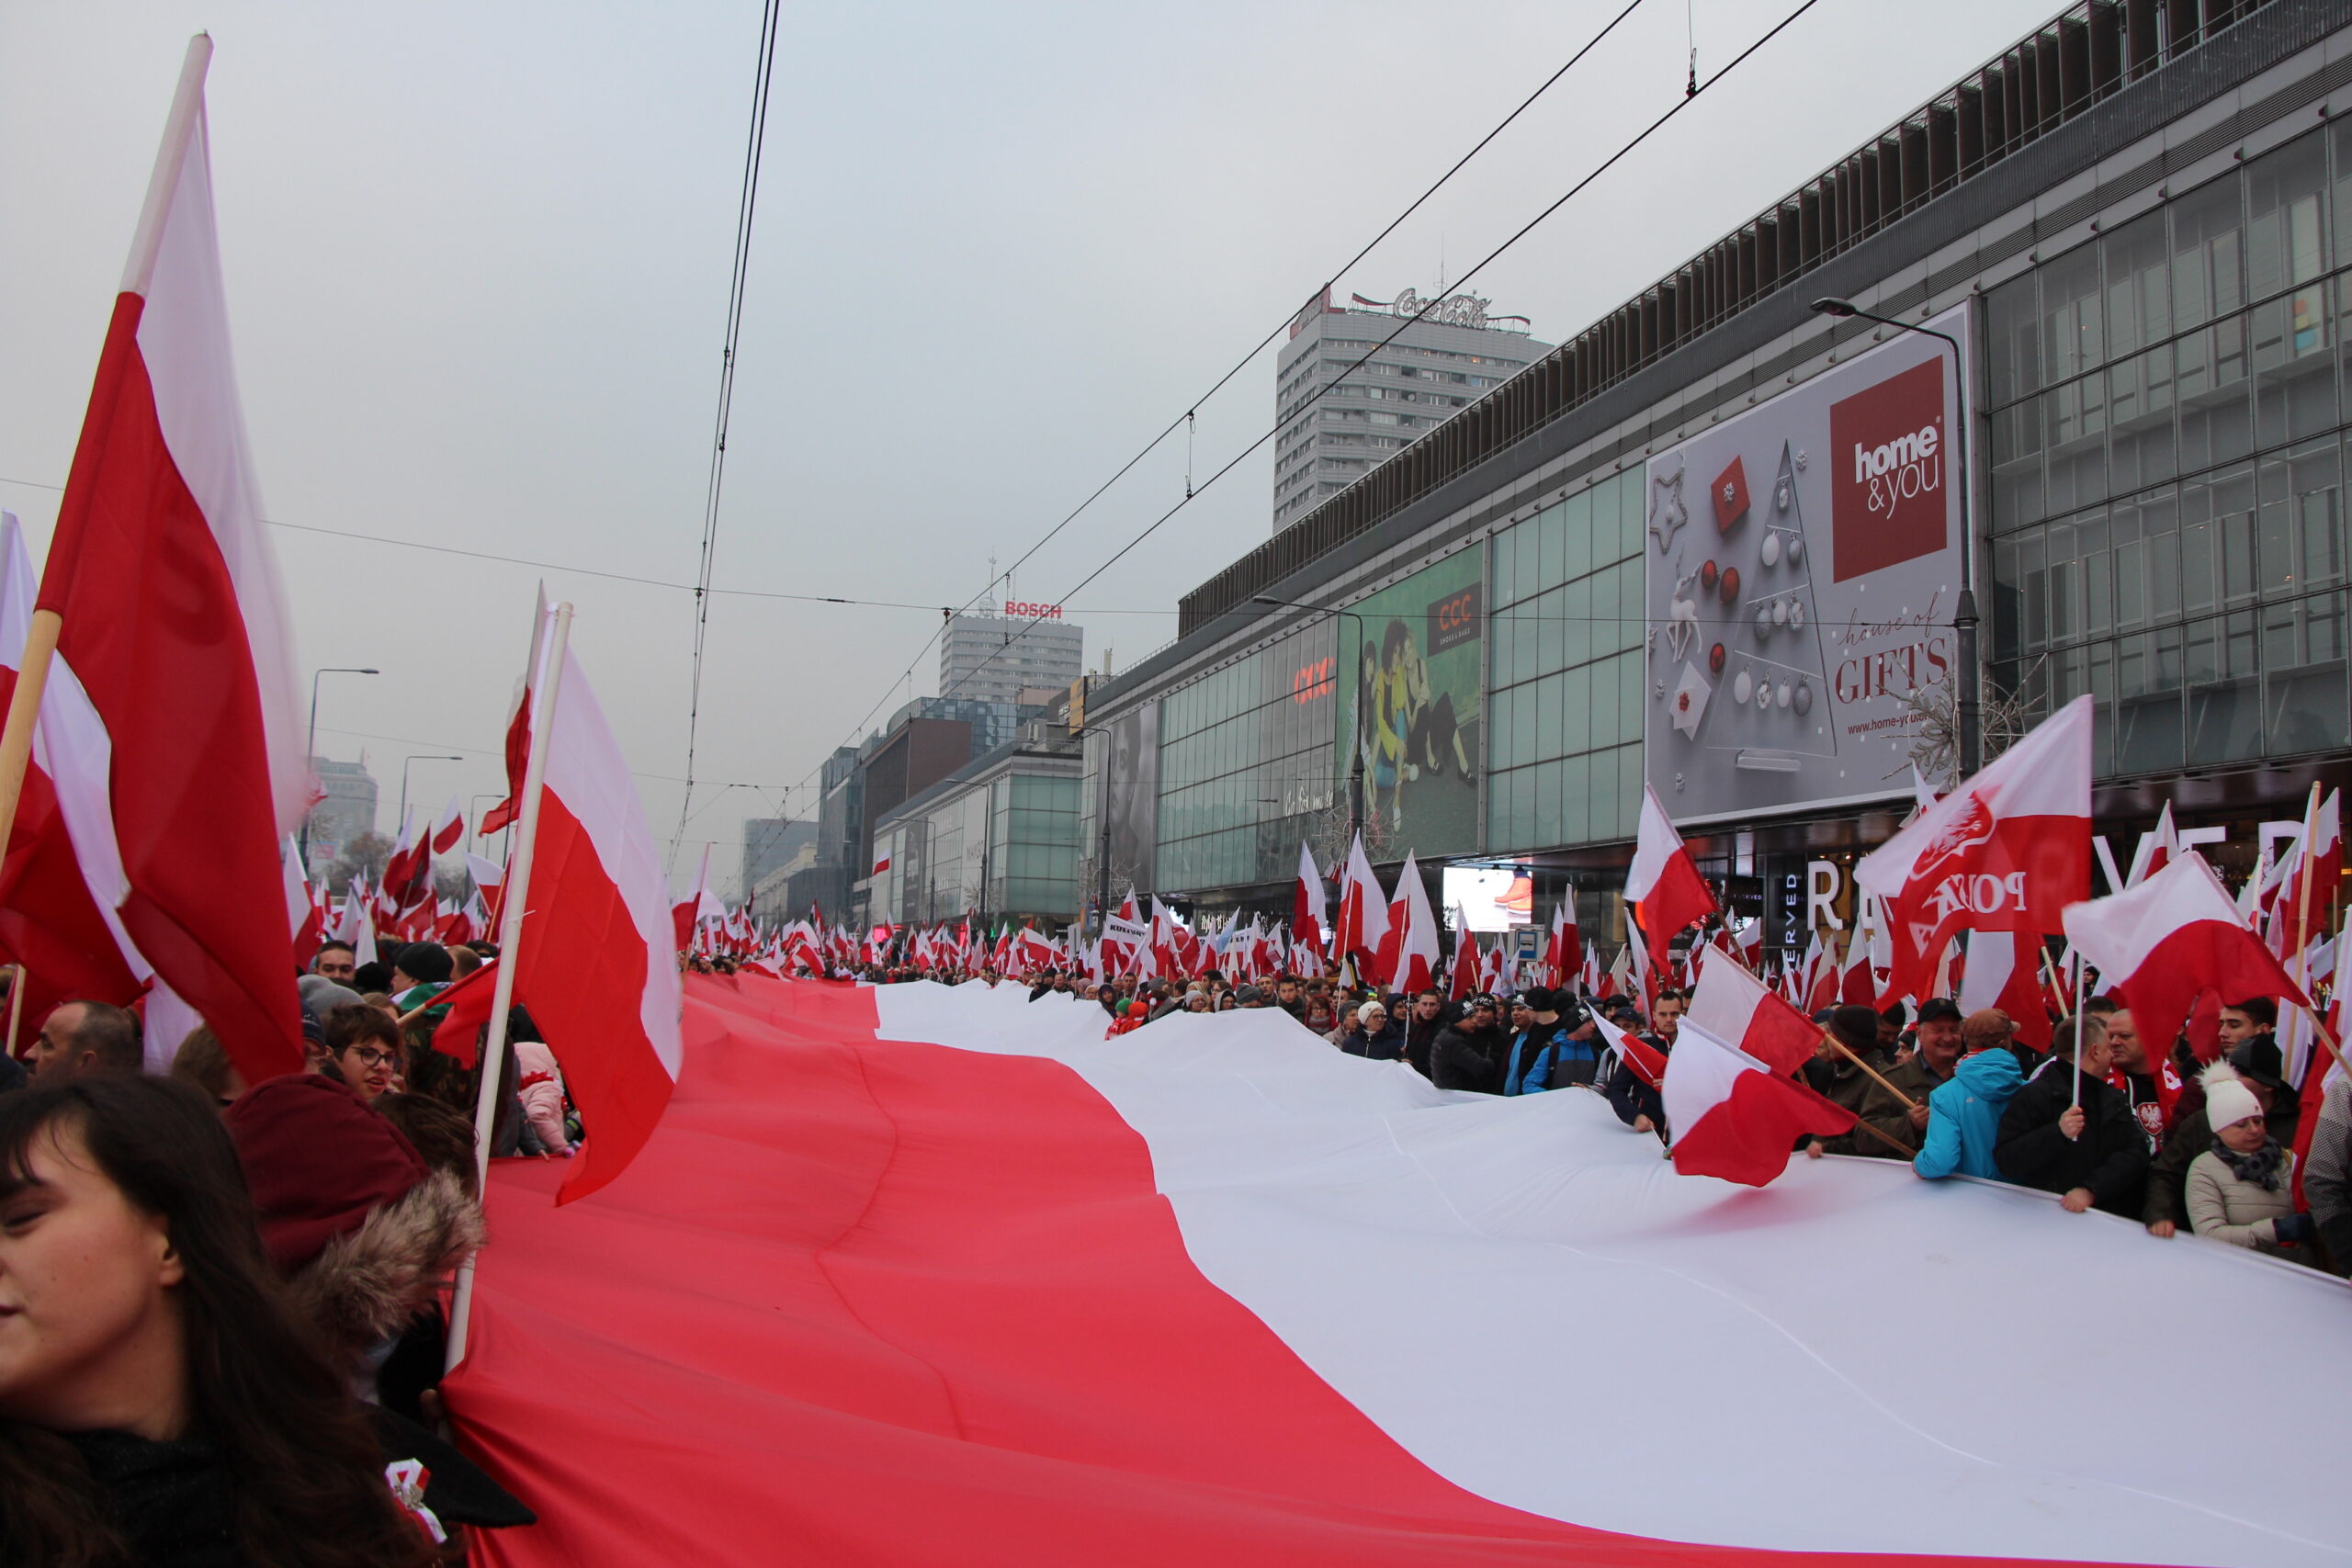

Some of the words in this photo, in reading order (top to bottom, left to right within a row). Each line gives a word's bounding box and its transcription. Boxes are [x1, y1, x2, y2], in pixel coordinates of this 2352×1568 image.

[1855, 425, 1938, 484] home
[1005, 602, 1061, 618] BOSCH
[1440, 594, 1472, 631] CCC
[1838, 607, 1906, 646] house
[1914, 591, 1940, 638] of
[1294, 657, 1335, 705] CCC
[1835, 637, 1948, 705] GIFTS
[1784, 874, 1798, 964] ERVED
